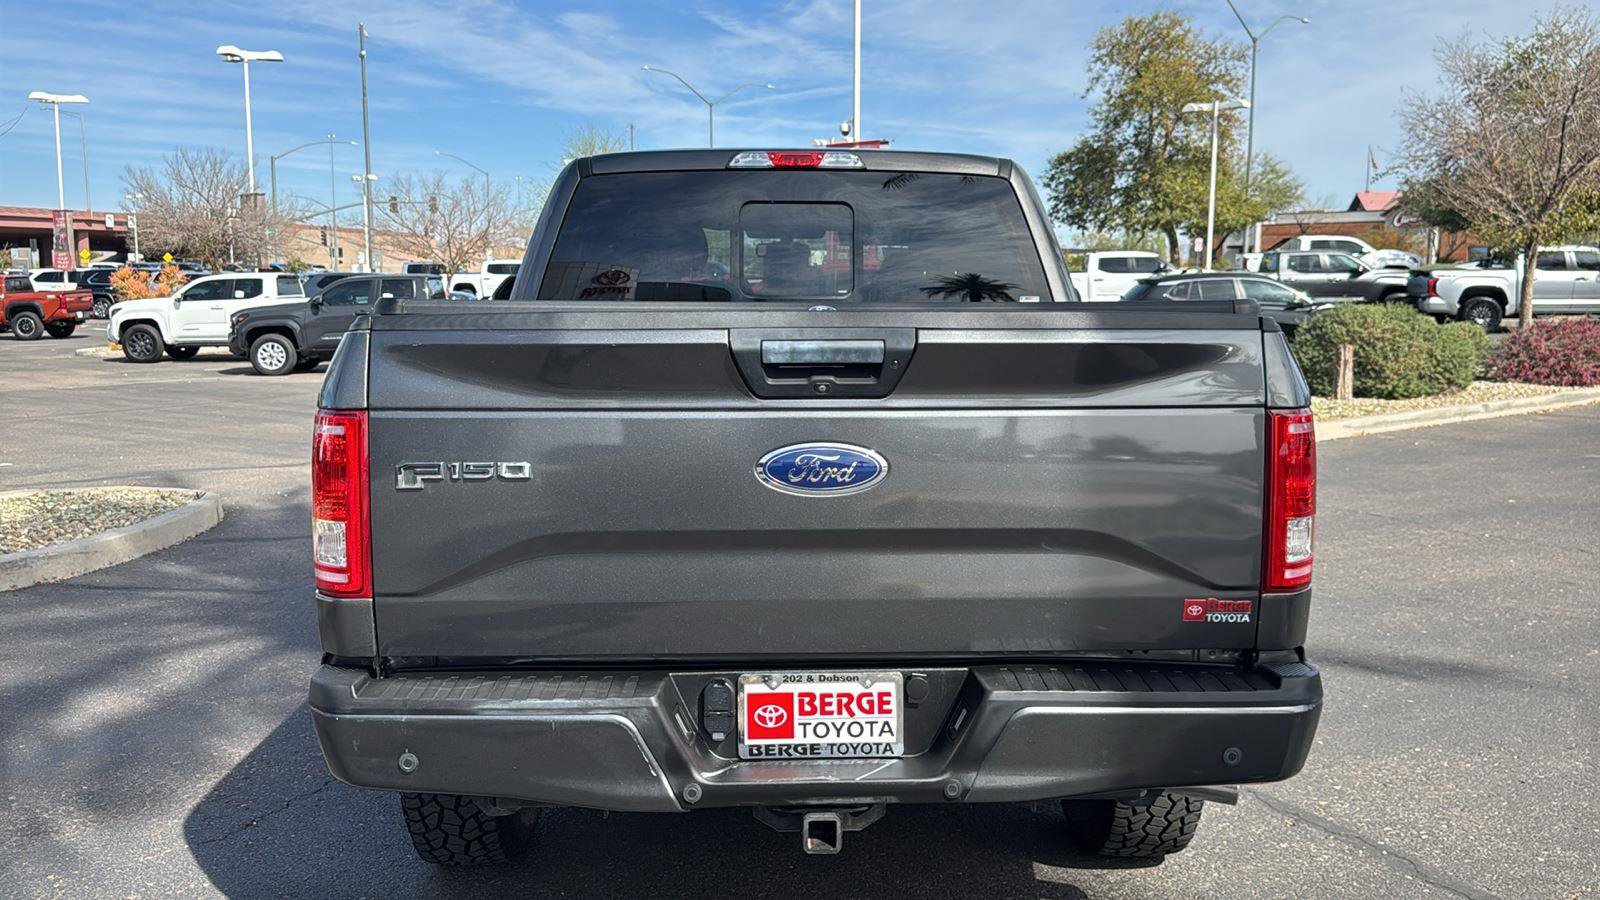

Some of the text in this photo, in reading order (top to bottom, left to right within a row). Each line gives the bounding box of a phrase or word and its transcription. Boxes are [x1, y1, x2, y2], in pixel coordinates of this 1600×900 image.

[788, 453, 858, 483] Ford
[1206, 613, 1250, 623] TOYOTA
[782, 674, 860, 683] 202 & Dobson
[797, 691, 893, 718] BERGE
[798, 720, 895, 739] TOYOTA
[749, 742, 895, 757] BERGE TOYOTA
